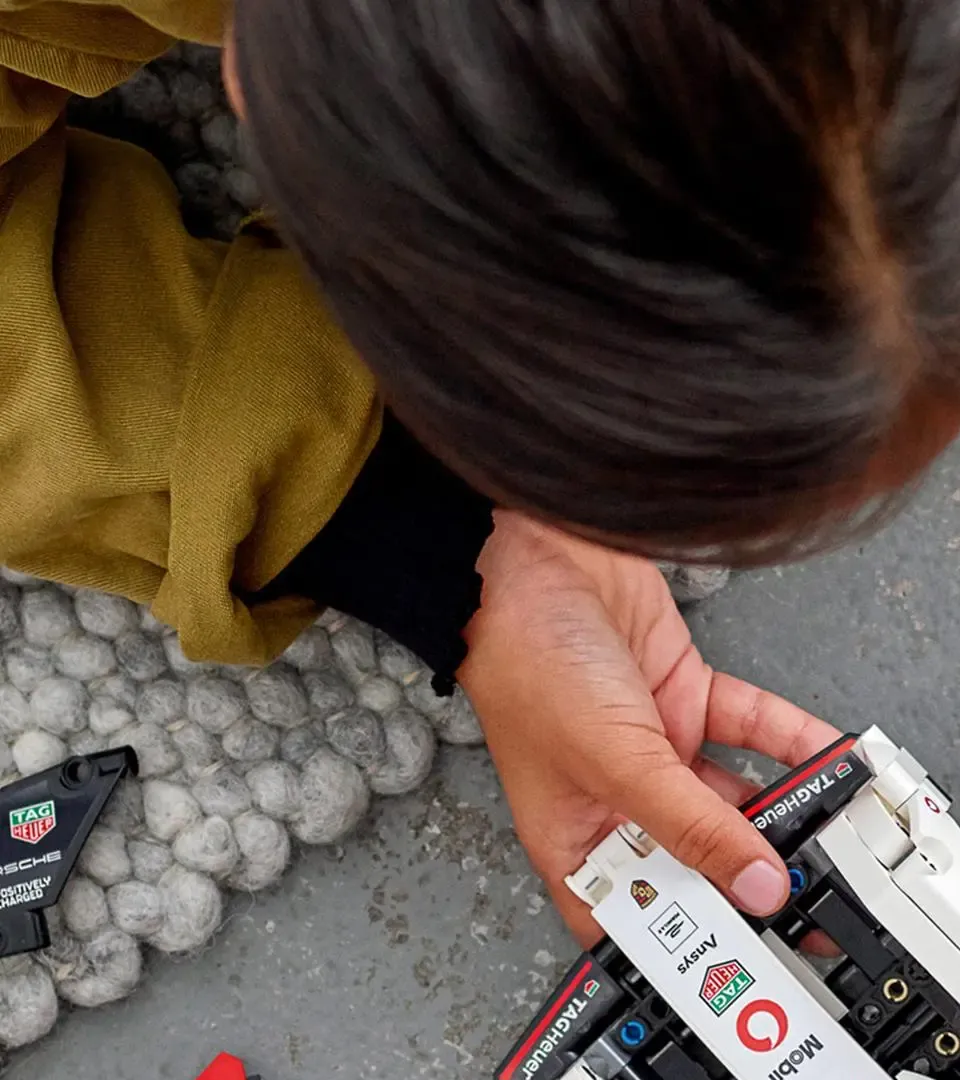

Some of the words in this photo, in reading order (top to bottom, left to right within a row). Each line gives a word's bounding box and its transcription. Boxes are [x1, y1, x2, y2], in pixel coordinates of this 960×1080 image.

[13, 804, 51, 823] TAG
[752, 774, 835, 829] TAGHeue
[14, 818, 52, 841] HEUER
[0, 850, 61, 876] SCHE
[0, 875, 52, 898] OSITIVELY
[0, 888, 44, 909] HARGED
[677, 933, 718, 974] Ansys
[703, 963, 740, 1000] HEUER
[712, 972, 751, 1009] TAG
